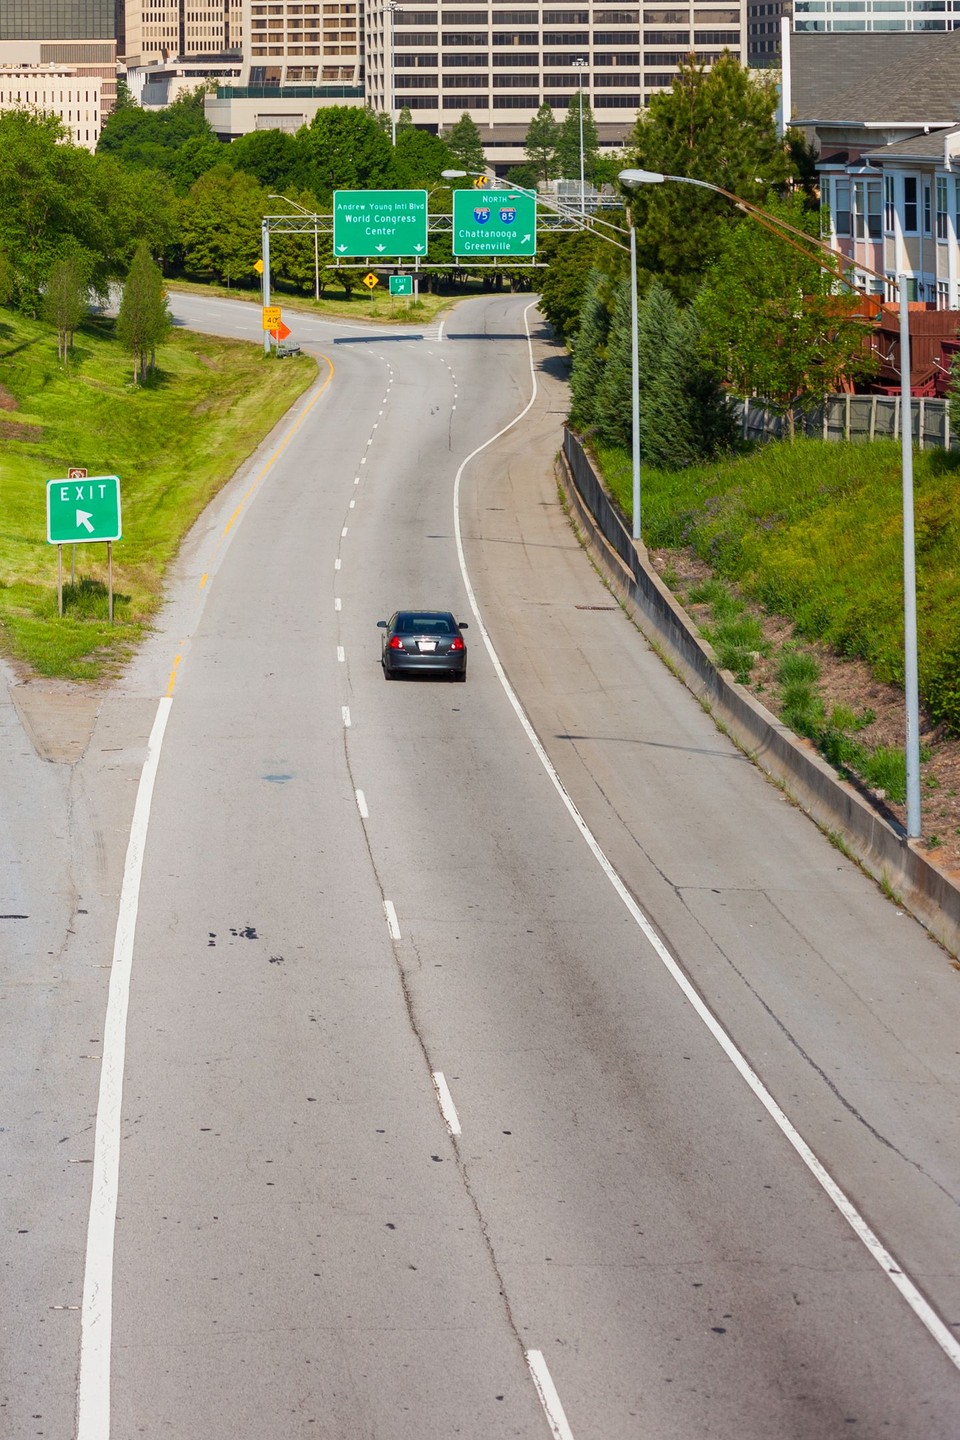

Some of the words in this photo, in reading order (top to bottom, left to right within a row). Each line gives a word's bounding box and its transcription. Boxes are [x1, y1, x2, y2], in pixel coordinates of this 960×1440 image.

[369, 203, 393, 211] Young
[345, 215, 370, 223] World
[374, 215, 416, 224] Congress
[476, 212, 488, 220] 75
[501, 212, 514, 221] 85
[365, 227, 396, 235] Center
[459, 230, 517, 240] Chattanooga
[464, 242, 511, 250] Greenville
[60, 484, 107, 501] EXIT
